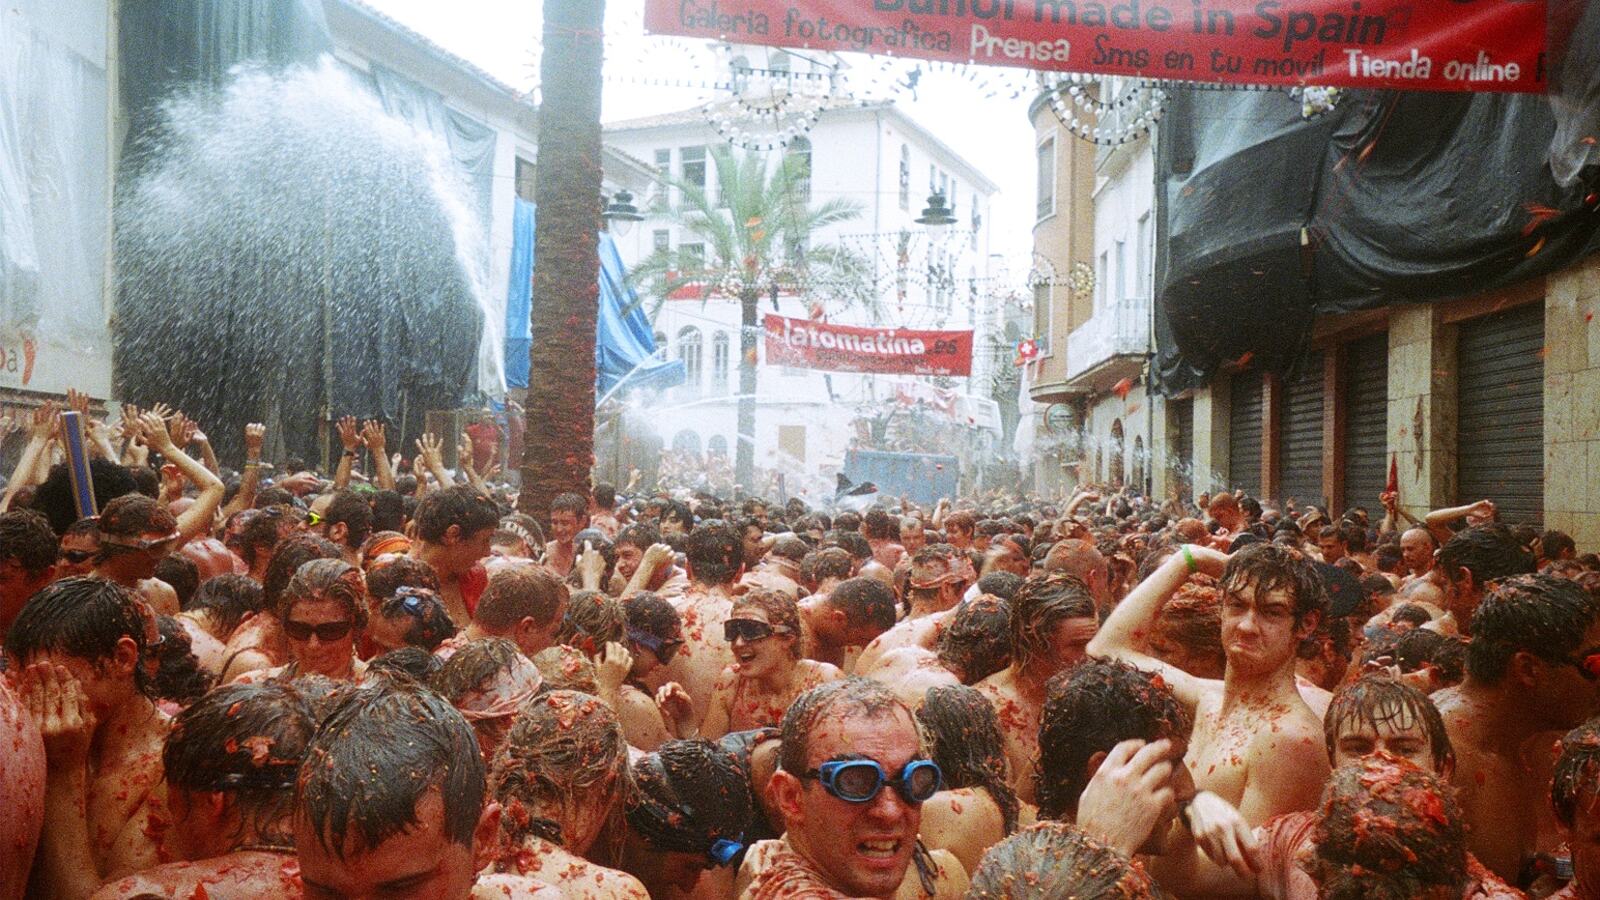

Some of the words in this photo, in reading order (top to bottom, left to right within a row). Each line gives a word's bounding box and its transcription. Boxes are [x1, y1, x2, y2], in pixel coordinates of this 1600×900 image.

[970, 23, 1071, 62] Prensa
[1092, 34, 1149, 68] Sms
[1164, 50, 1194, 71] en
[1209, 48, 1243, 74] tu
[1343, 48, 1432, 79] Tienda
[1444, 50, 1521, 82] online
[1034, 0, 1173, 32] made
[1192, 0, 1234, 36] in
[1253, 1, 1387, 53] Spain
